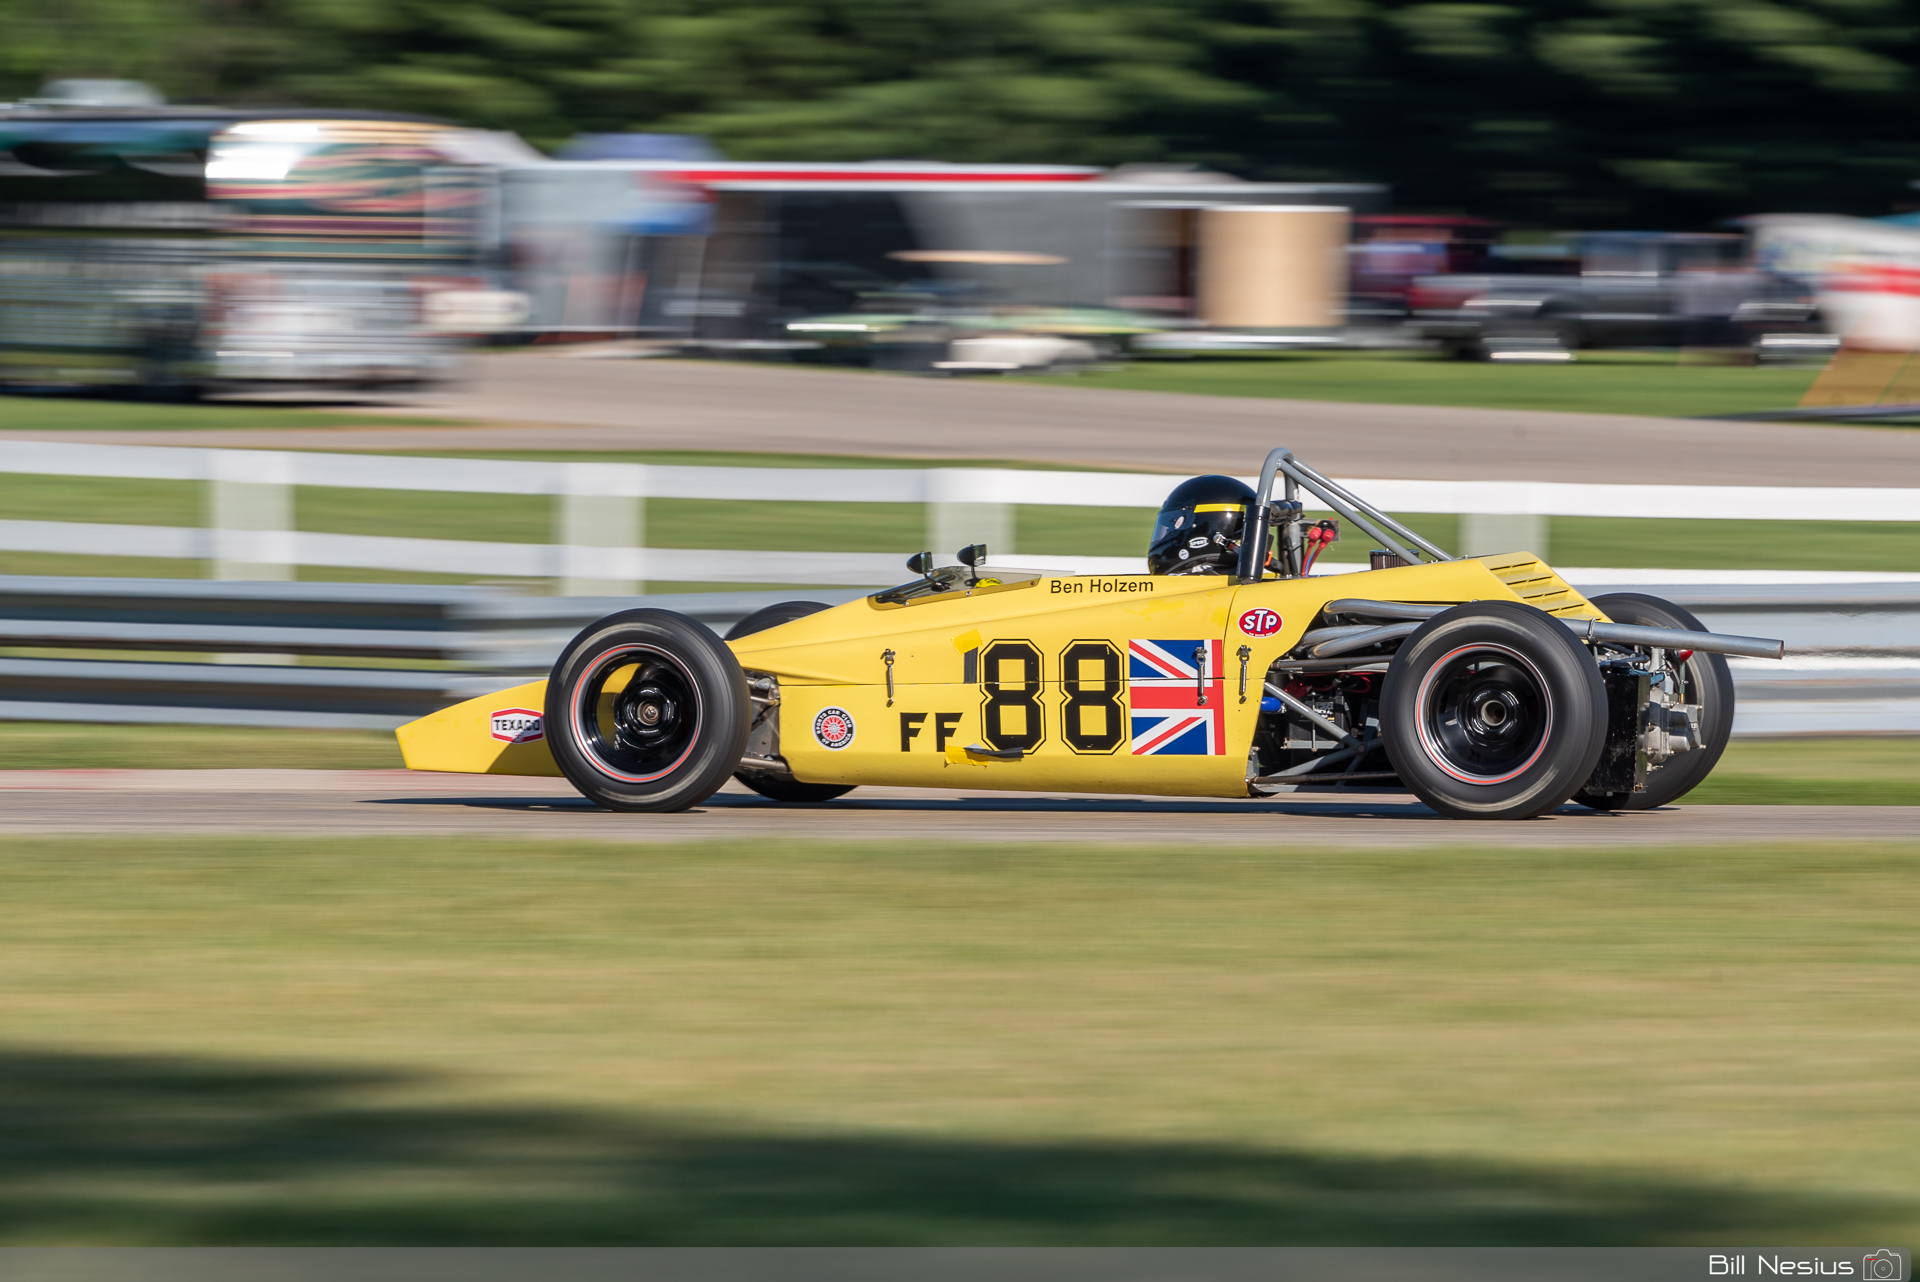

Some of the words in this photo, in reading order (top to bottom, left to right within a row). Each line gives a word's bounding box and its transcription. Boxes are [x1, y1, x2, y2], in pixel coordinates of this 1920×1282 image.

[1050, 579, 1083, 594] Ben
[1090, 578, 1154, 593] Holzem
[1243, 609, 1278, 633] STP
[494, 719, 540, 731] TEXACO
[841, 713, 853, 729] CLUB
[899, 712, 964, 752] FF
